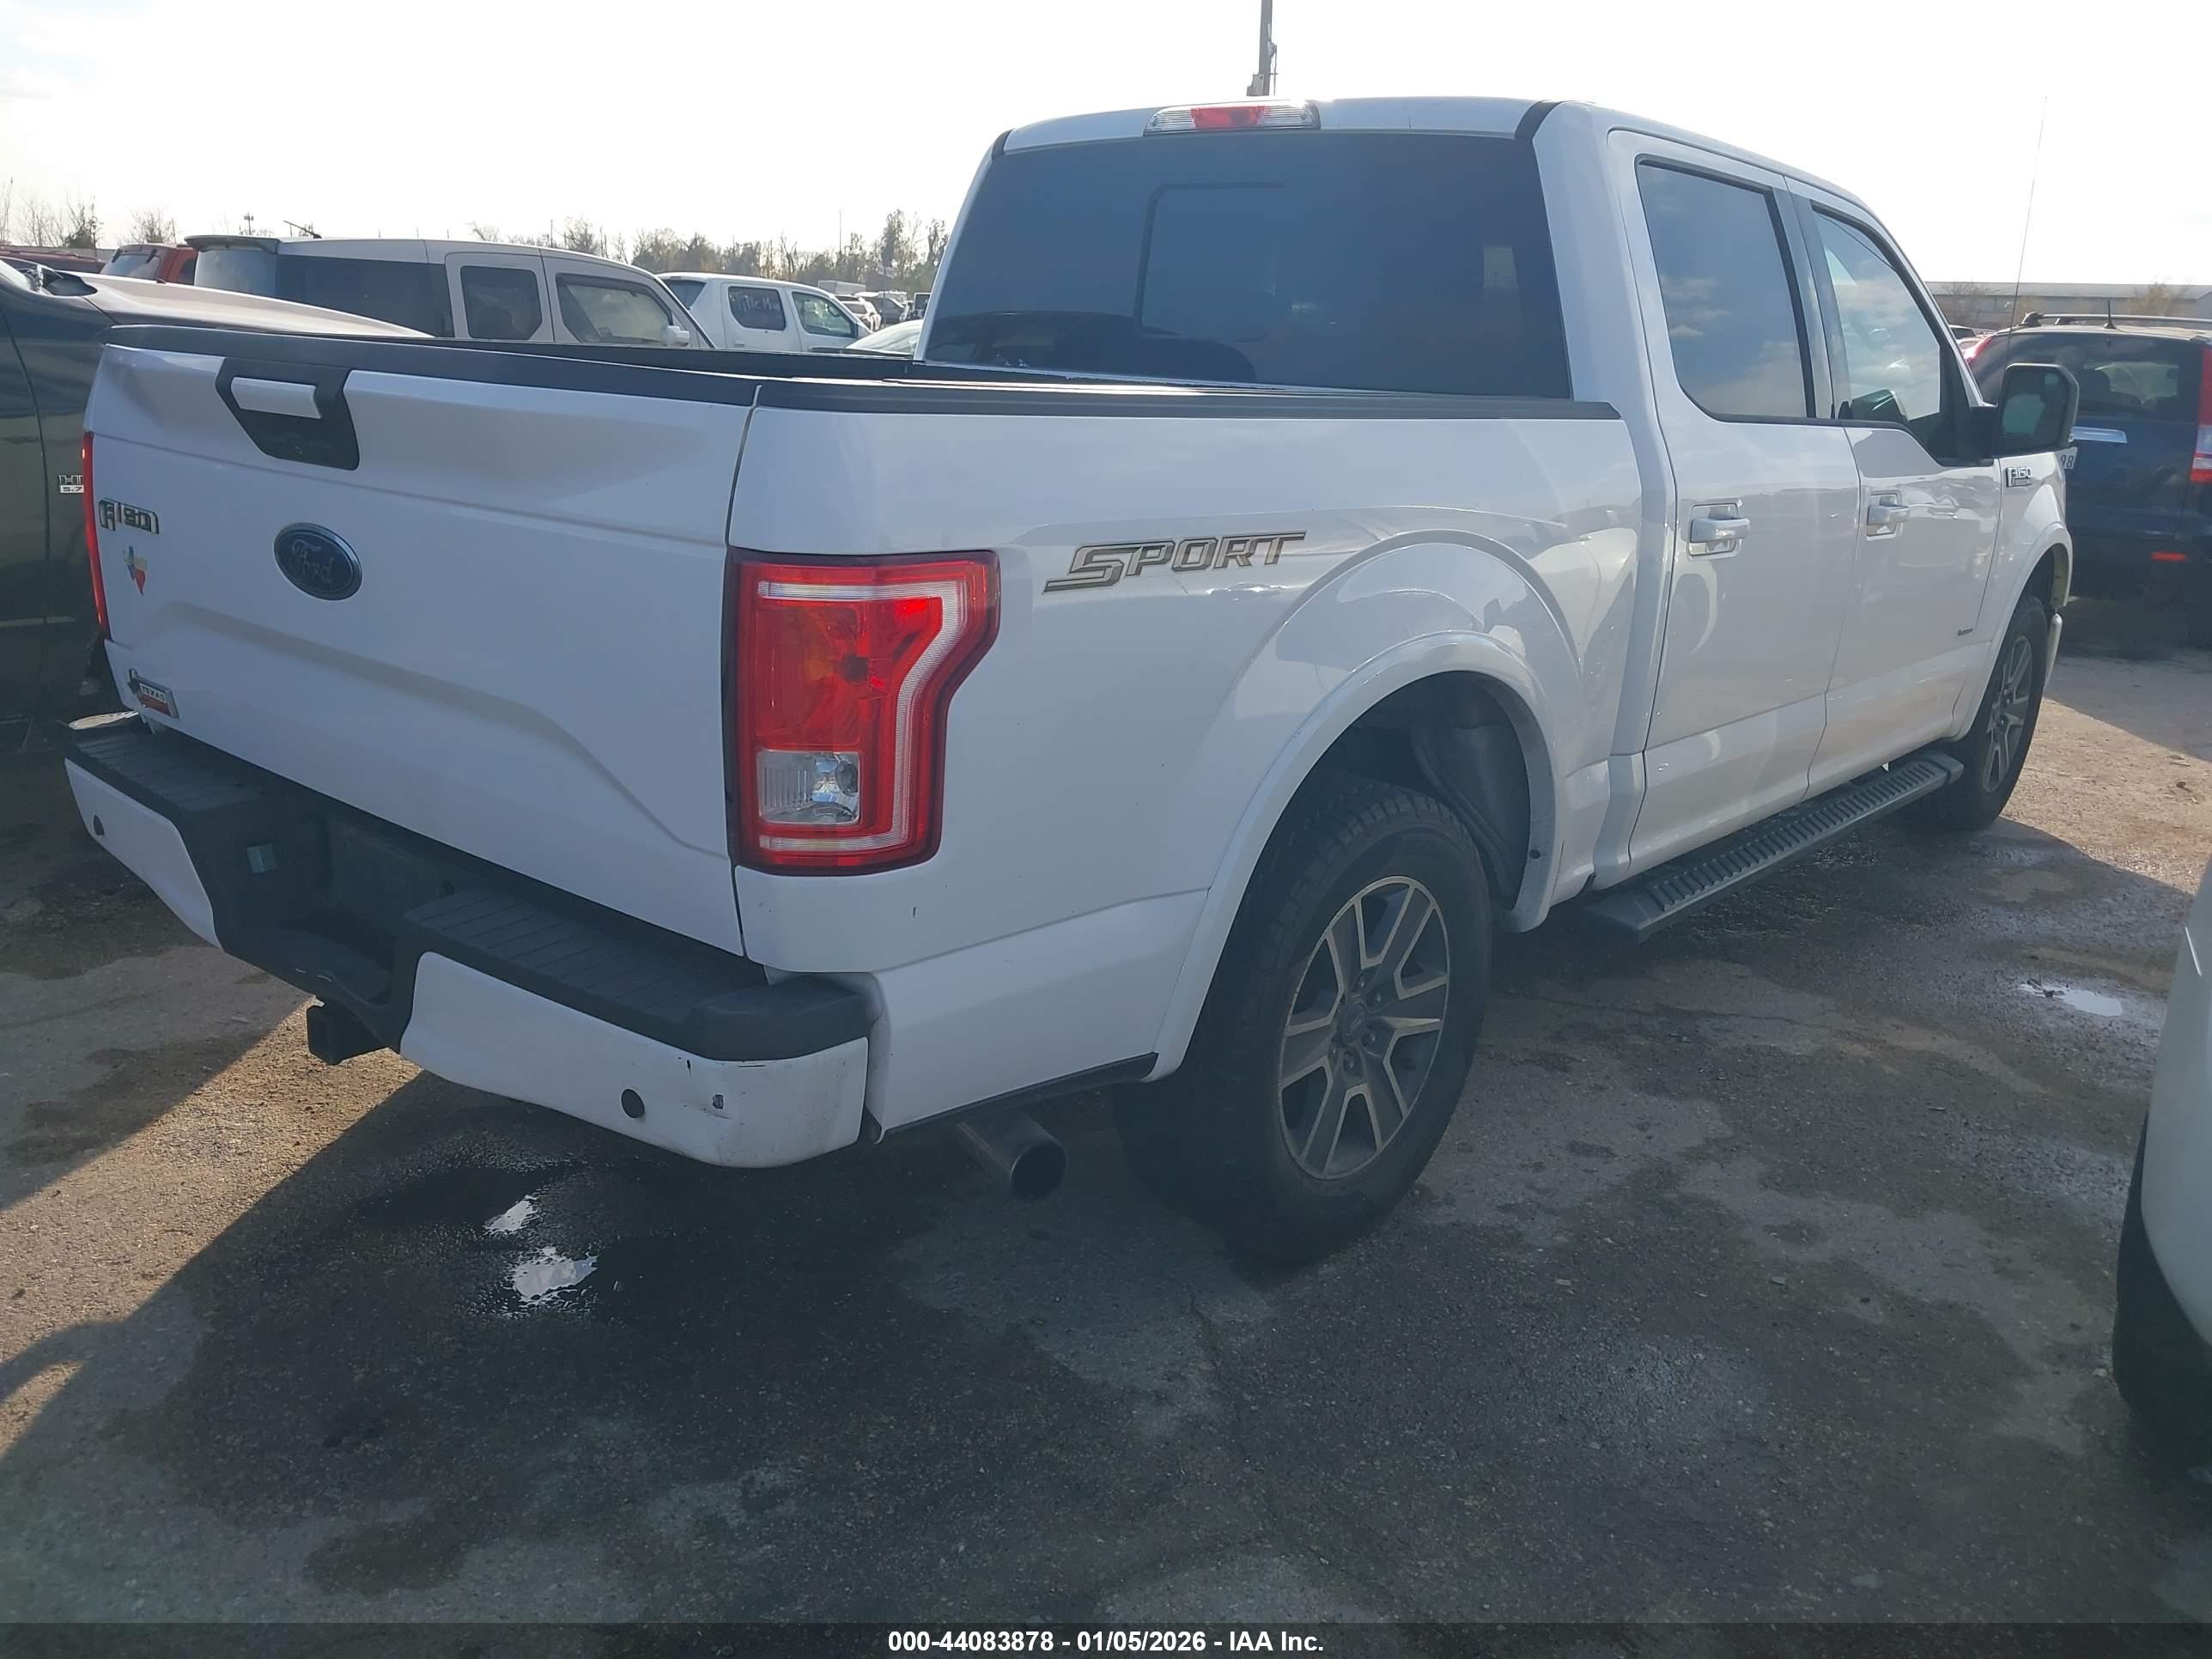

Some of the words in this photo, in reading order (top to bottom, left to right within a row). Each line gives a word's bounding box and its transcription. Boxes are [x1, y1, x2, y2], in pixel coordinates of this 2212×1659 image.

[289, 538, 336, 585] Ford
[1042, 530, 1307, 594] SPORT
[139, 684, 167, 701] TEXAS
